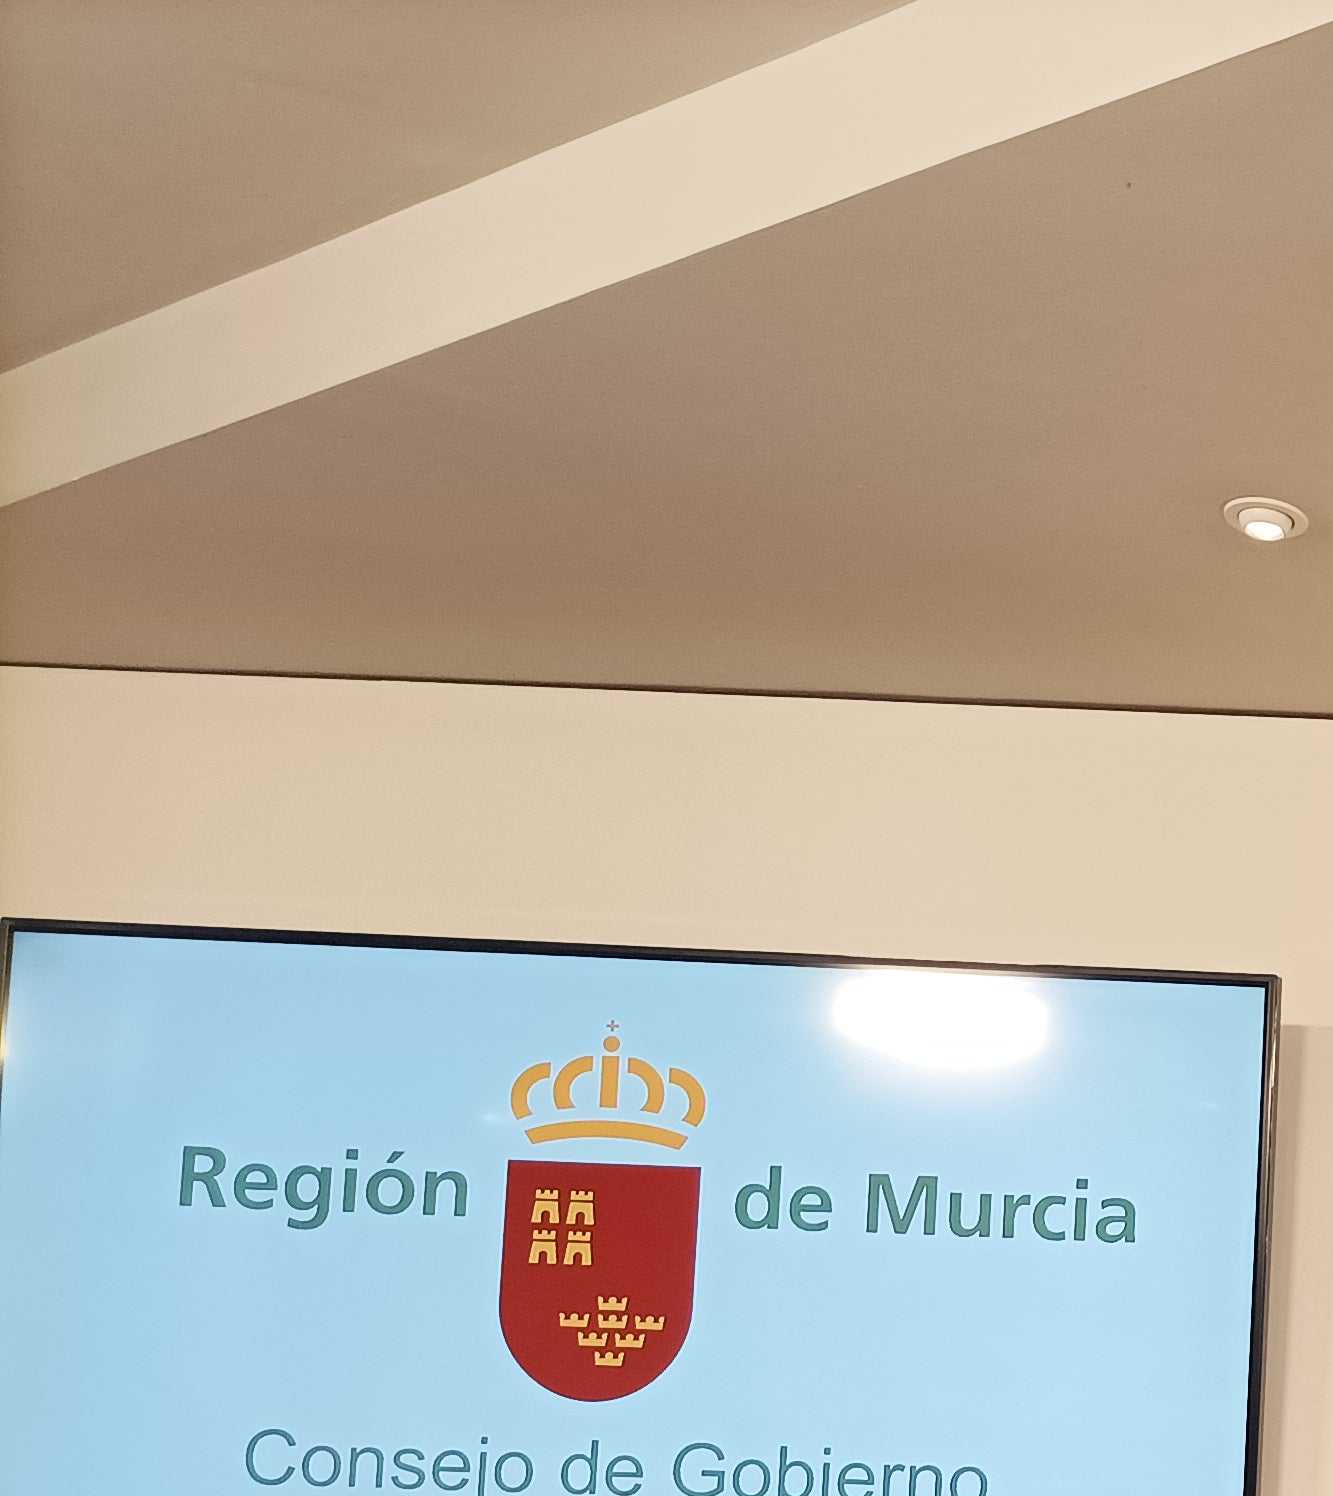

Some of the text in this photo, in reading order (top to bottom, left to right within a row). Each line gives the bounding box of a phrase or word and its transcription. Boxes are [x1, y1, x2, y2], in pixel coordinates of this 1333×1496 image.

[178, 1145, 1136, 1244] Región de Murcia
[560, 1439, 644, 1496] de
